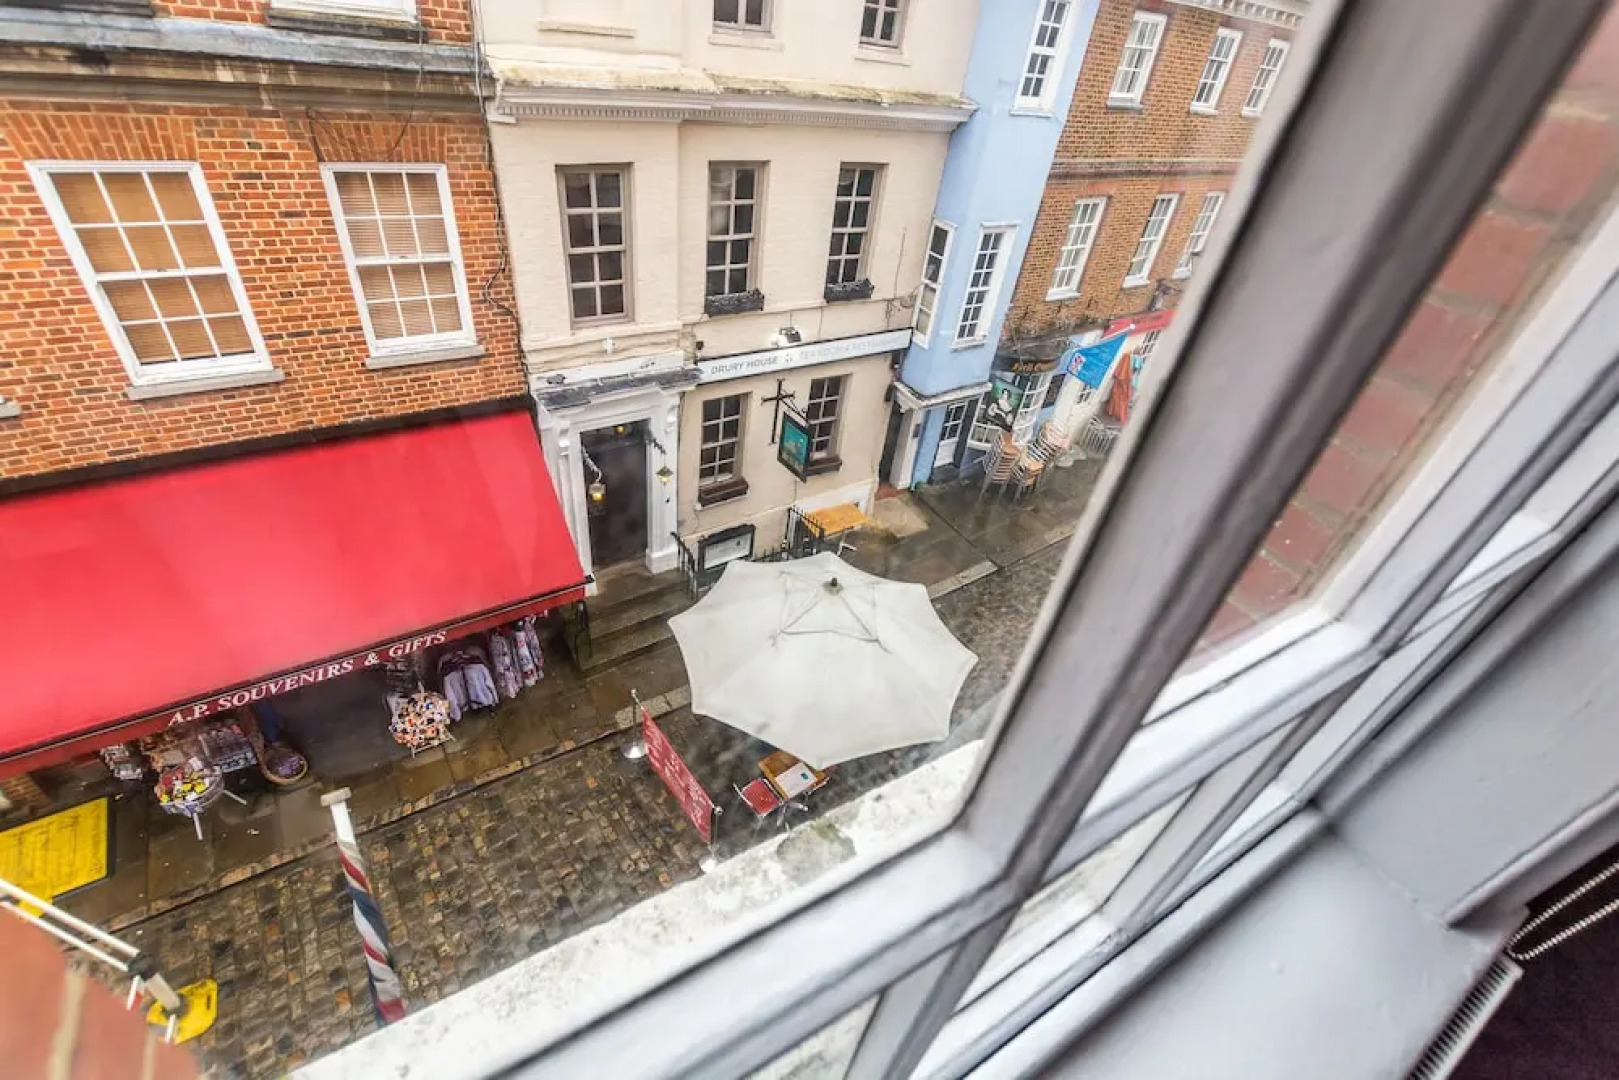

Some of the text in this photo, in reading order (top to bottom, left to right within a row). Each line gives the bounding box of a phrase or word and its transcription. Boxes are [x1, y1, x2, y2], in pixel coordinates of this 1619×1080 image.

[711, 362, 744, 375] DRURY
[746, 356, 778, 369] HOUSE
[168, 631, 447, 726] A.P. SOUVENIRS & GIFTS
